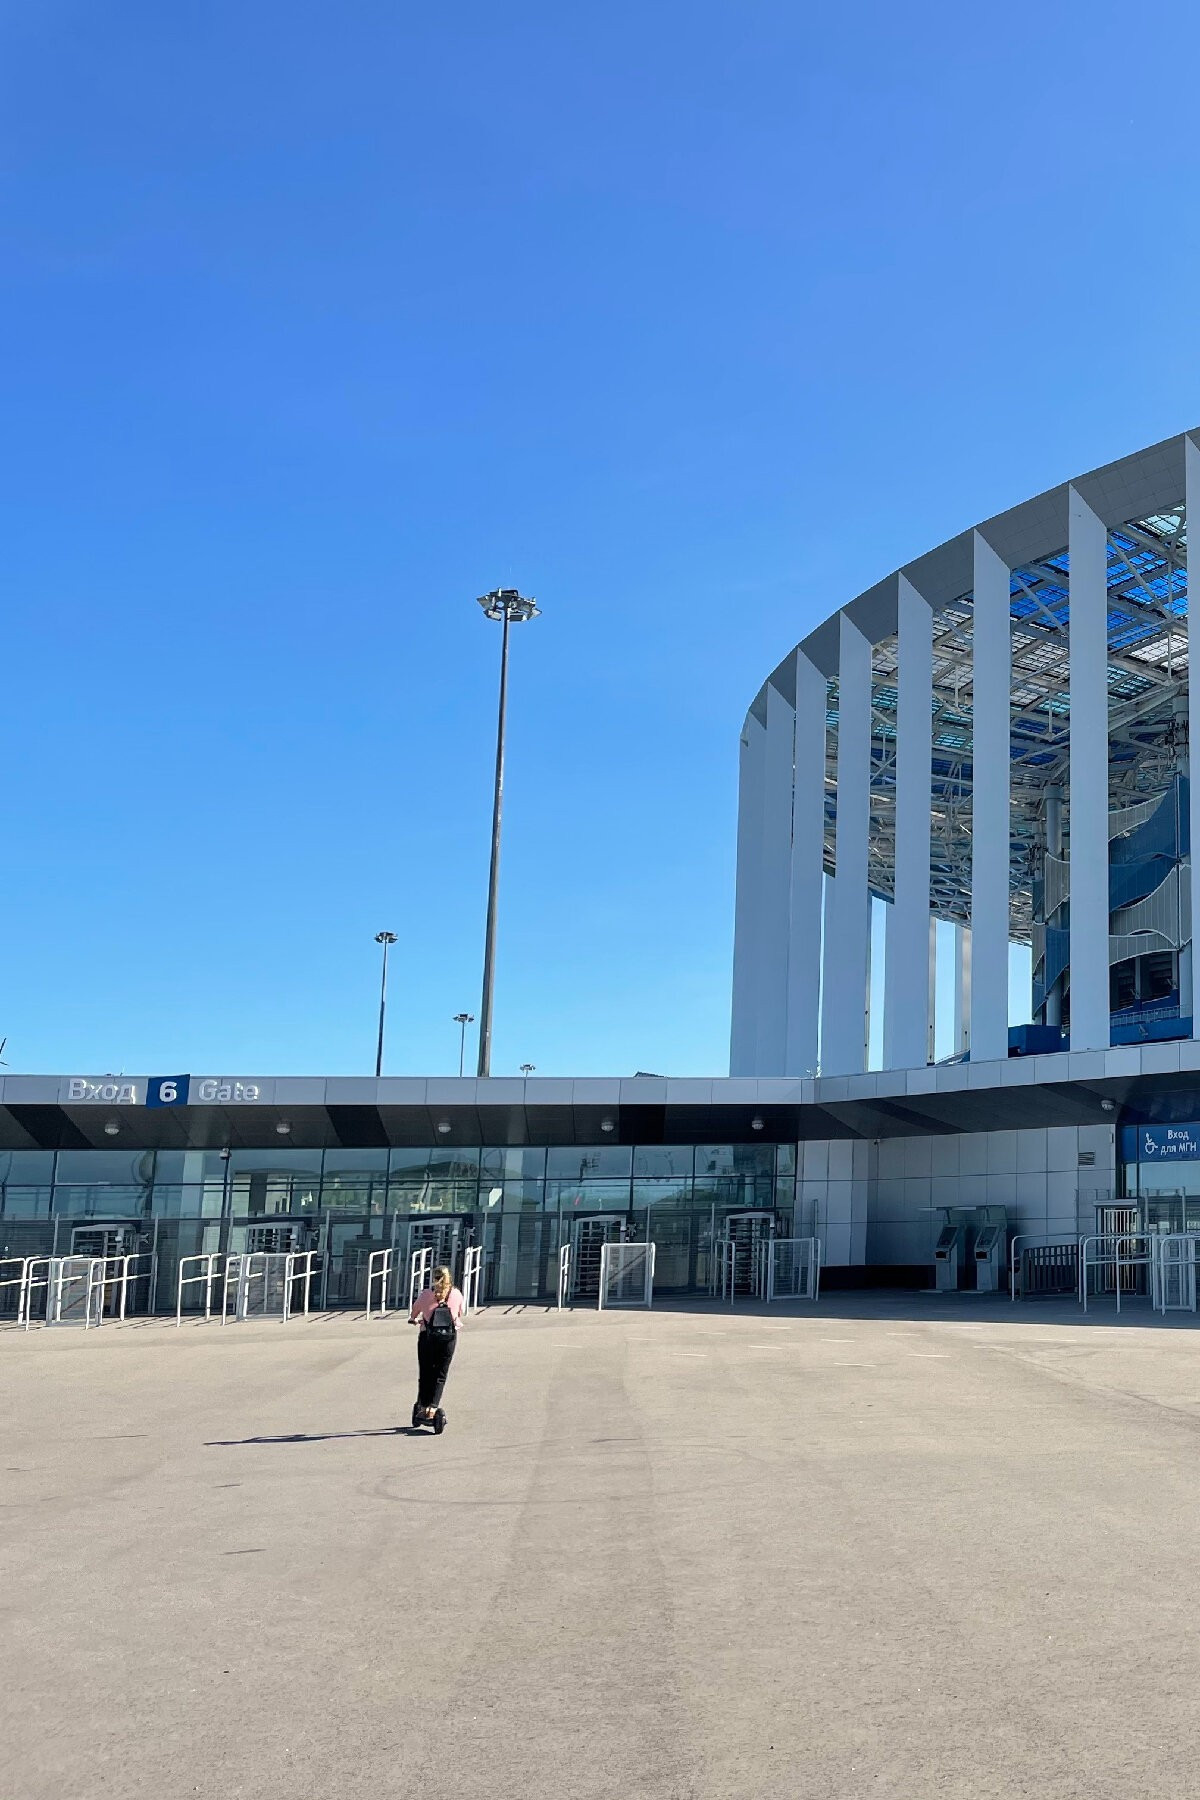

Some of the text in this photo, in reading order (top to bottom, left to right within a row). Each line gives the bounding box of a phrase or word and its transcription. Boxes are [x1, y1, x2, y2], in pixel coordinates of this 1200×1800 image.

[67, 1078, 259, 1105] Вход 6 Gate
[1167, 1129, 1189, 1142] Вход
[1160, 1141, 1197, 1156] для МГН
